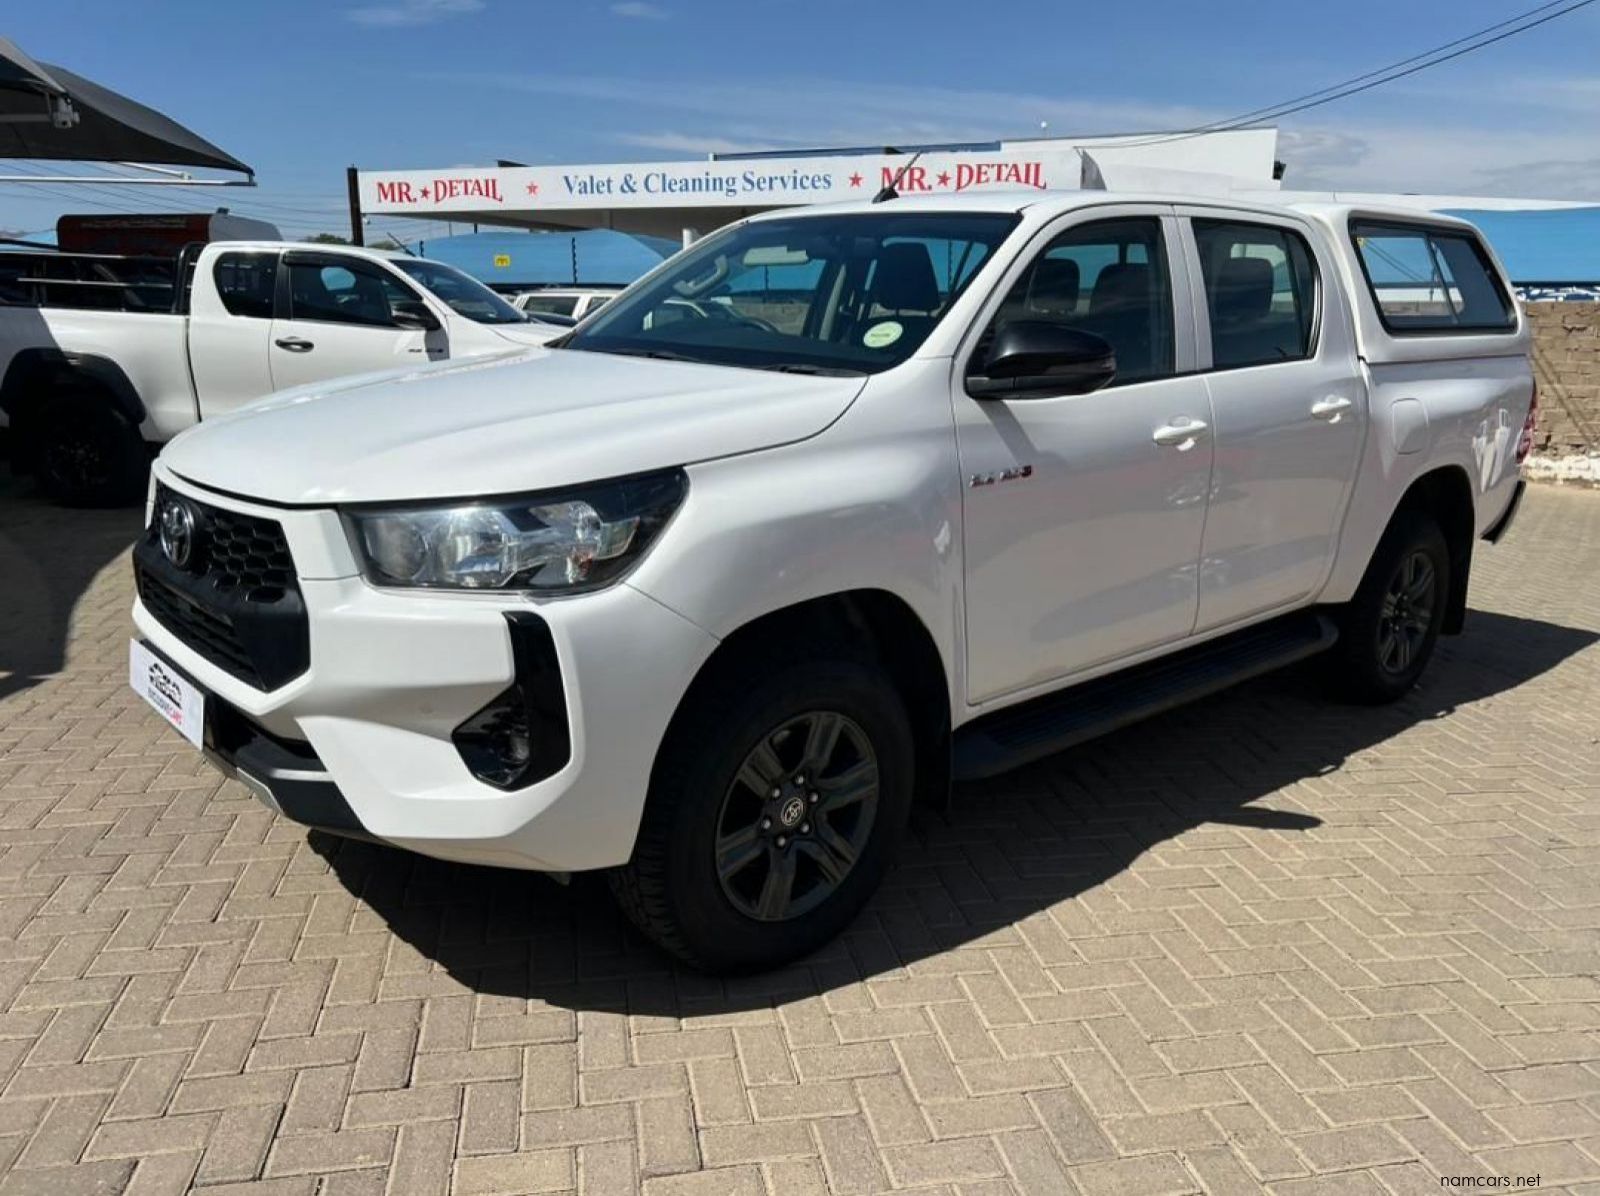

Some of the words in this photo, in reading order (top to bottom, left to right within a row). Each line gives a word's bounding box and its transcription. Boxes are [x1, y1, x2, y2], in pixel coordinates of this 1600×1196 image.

[377, 181, 417, 203] MR.
[433, 178, 503, 203] DETAIL
[563, 174, 613, 194] Valet
[620, 173, 637, 194] &
[644, 171, 737, 197] Cleaning
[742, 169, 832, 191] Services
[881, 166, 932, 191] MR.
[955, 162, 1047, 191] DETAIL
